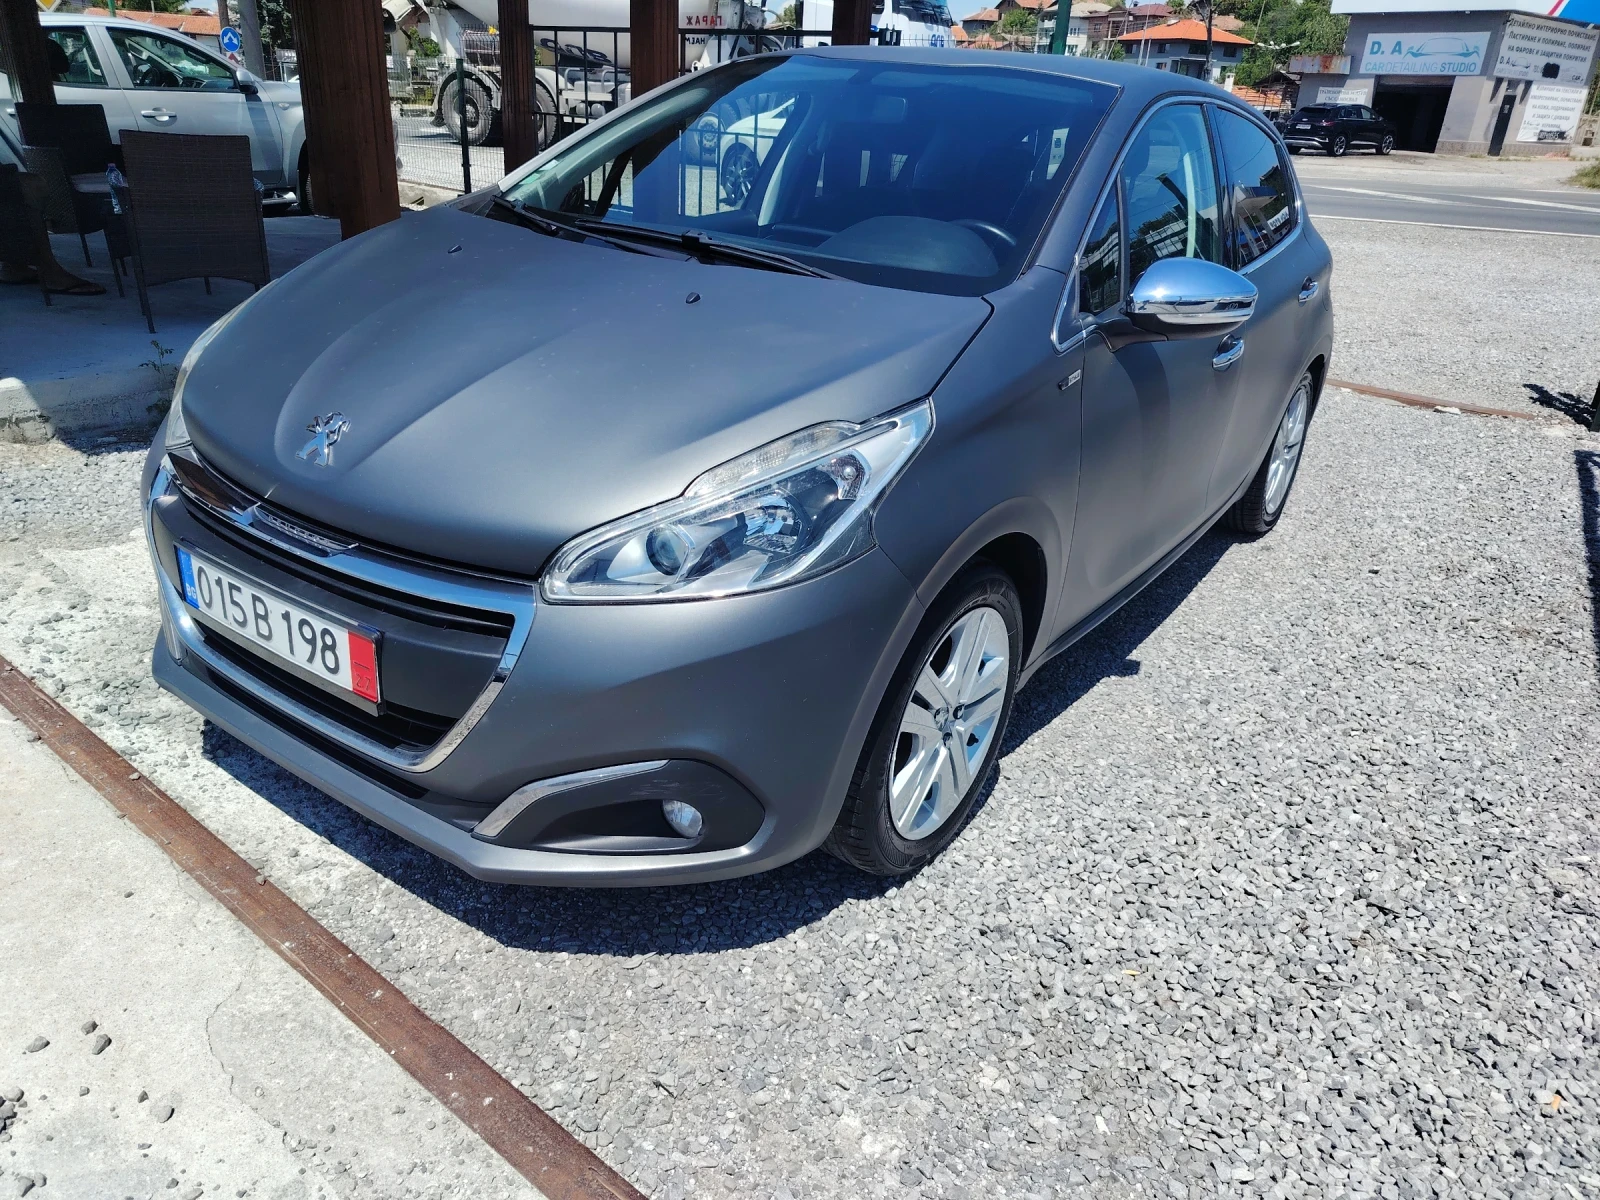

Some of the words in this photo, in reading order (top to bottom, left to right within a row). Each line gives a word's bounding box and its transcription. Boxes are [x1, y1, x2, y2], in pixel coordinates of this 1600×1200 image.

[1536, 24, 1567, 36] ИНТЕРИОРНО
[1369, 41, 1385, 55] D.
[1391, 41, 1402, 55] A
[1515, 46, 1536, 55] ФАРОВЕ
[1440, 62, 1477, 73] STUDIO
[186, 583, 197, 599] BG
[355, 673, 372, 690] 27
